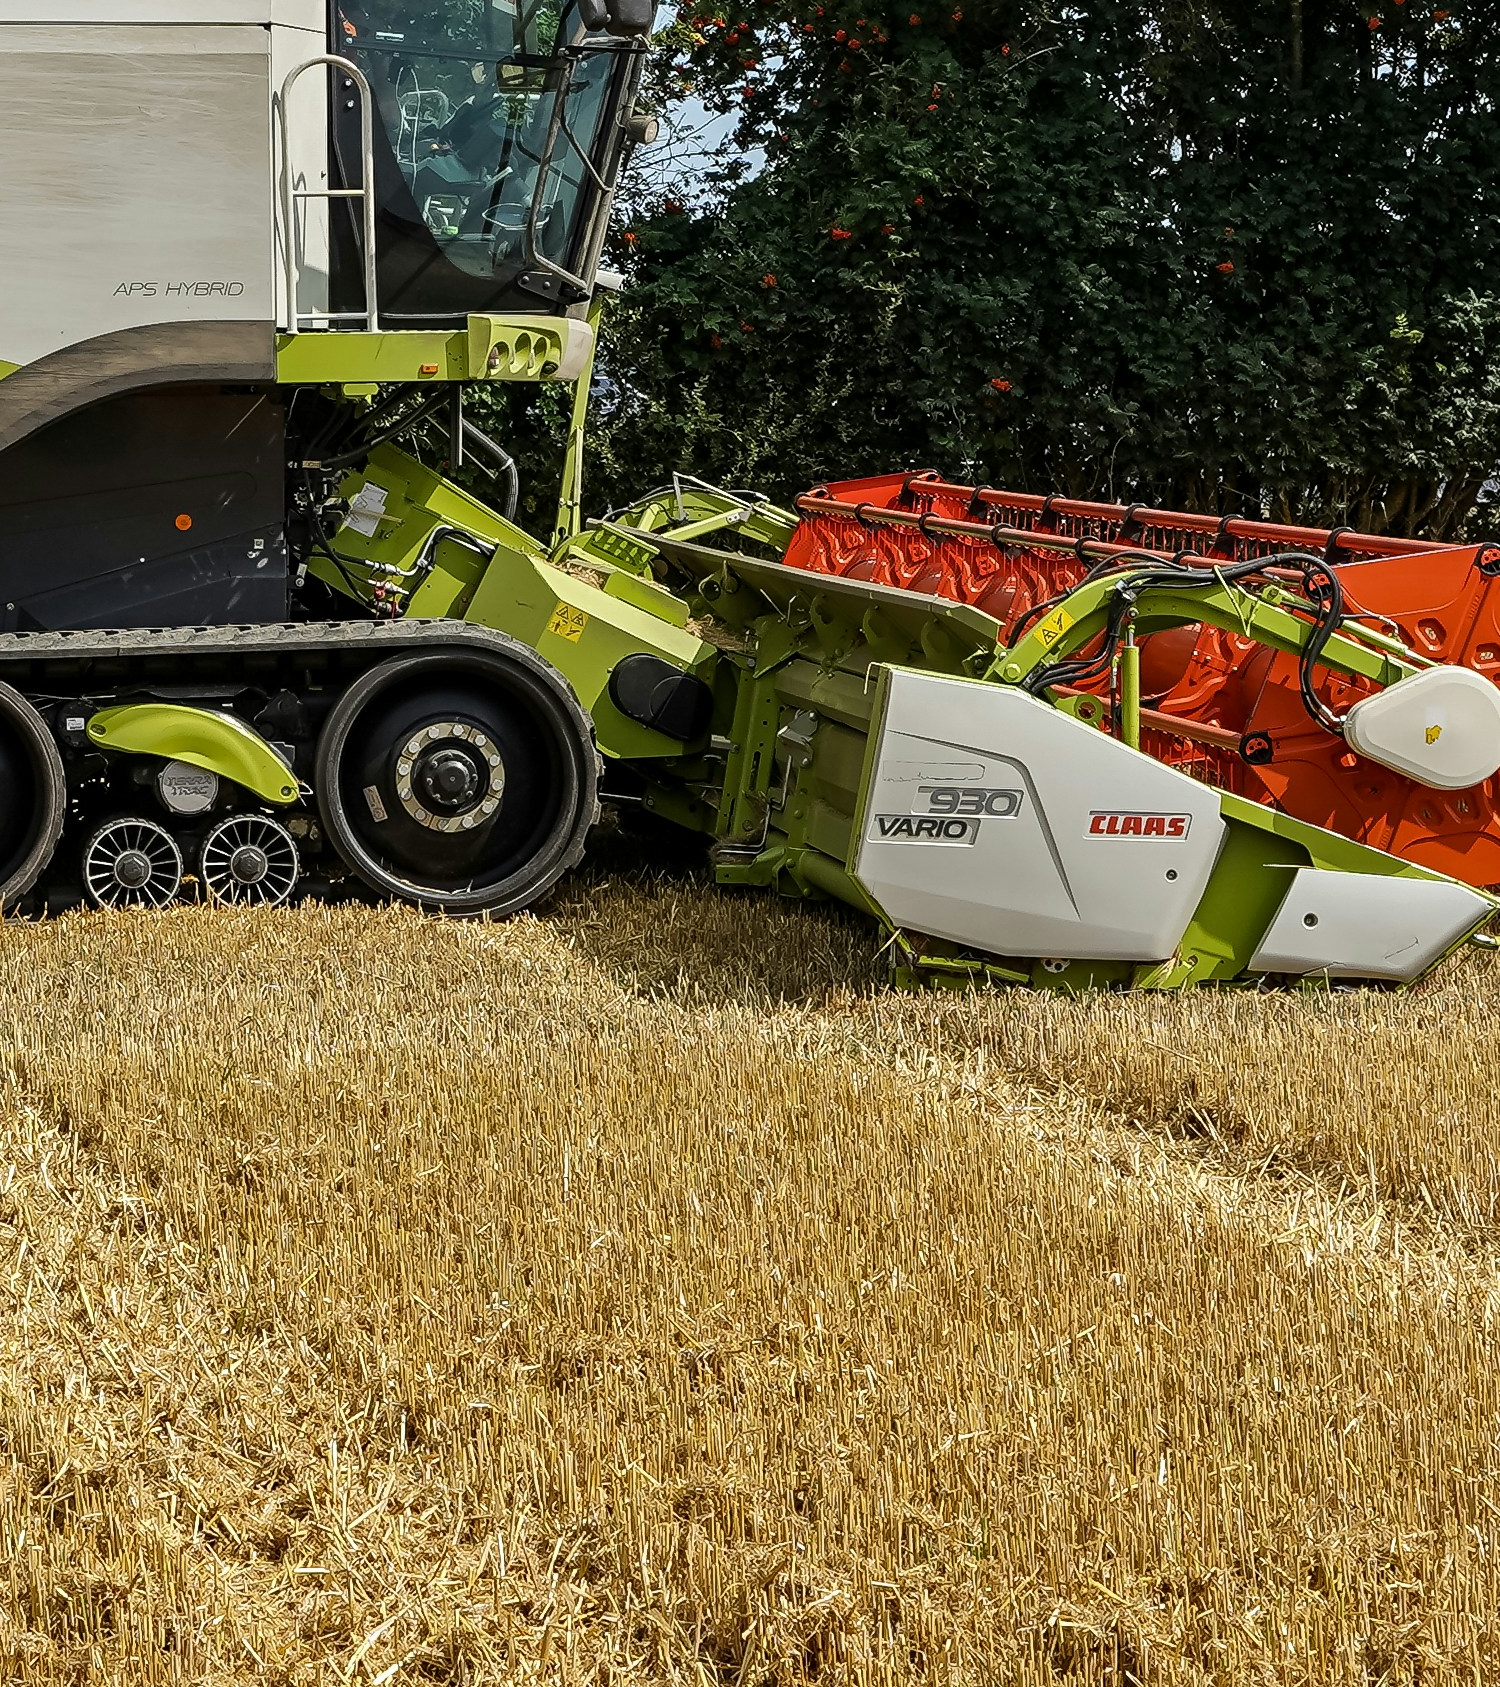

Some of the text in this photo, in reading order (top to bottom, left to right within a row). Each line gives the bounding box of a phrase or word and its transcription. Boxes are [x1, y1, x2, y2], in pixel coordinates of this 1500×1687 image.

[113, 282, 244, 296] APS HYBRID
[928, 789, 1018, 816] 930
[878, 817, 968, 839] VARIO
[1089, 815, 1186, 837] CLAAS
